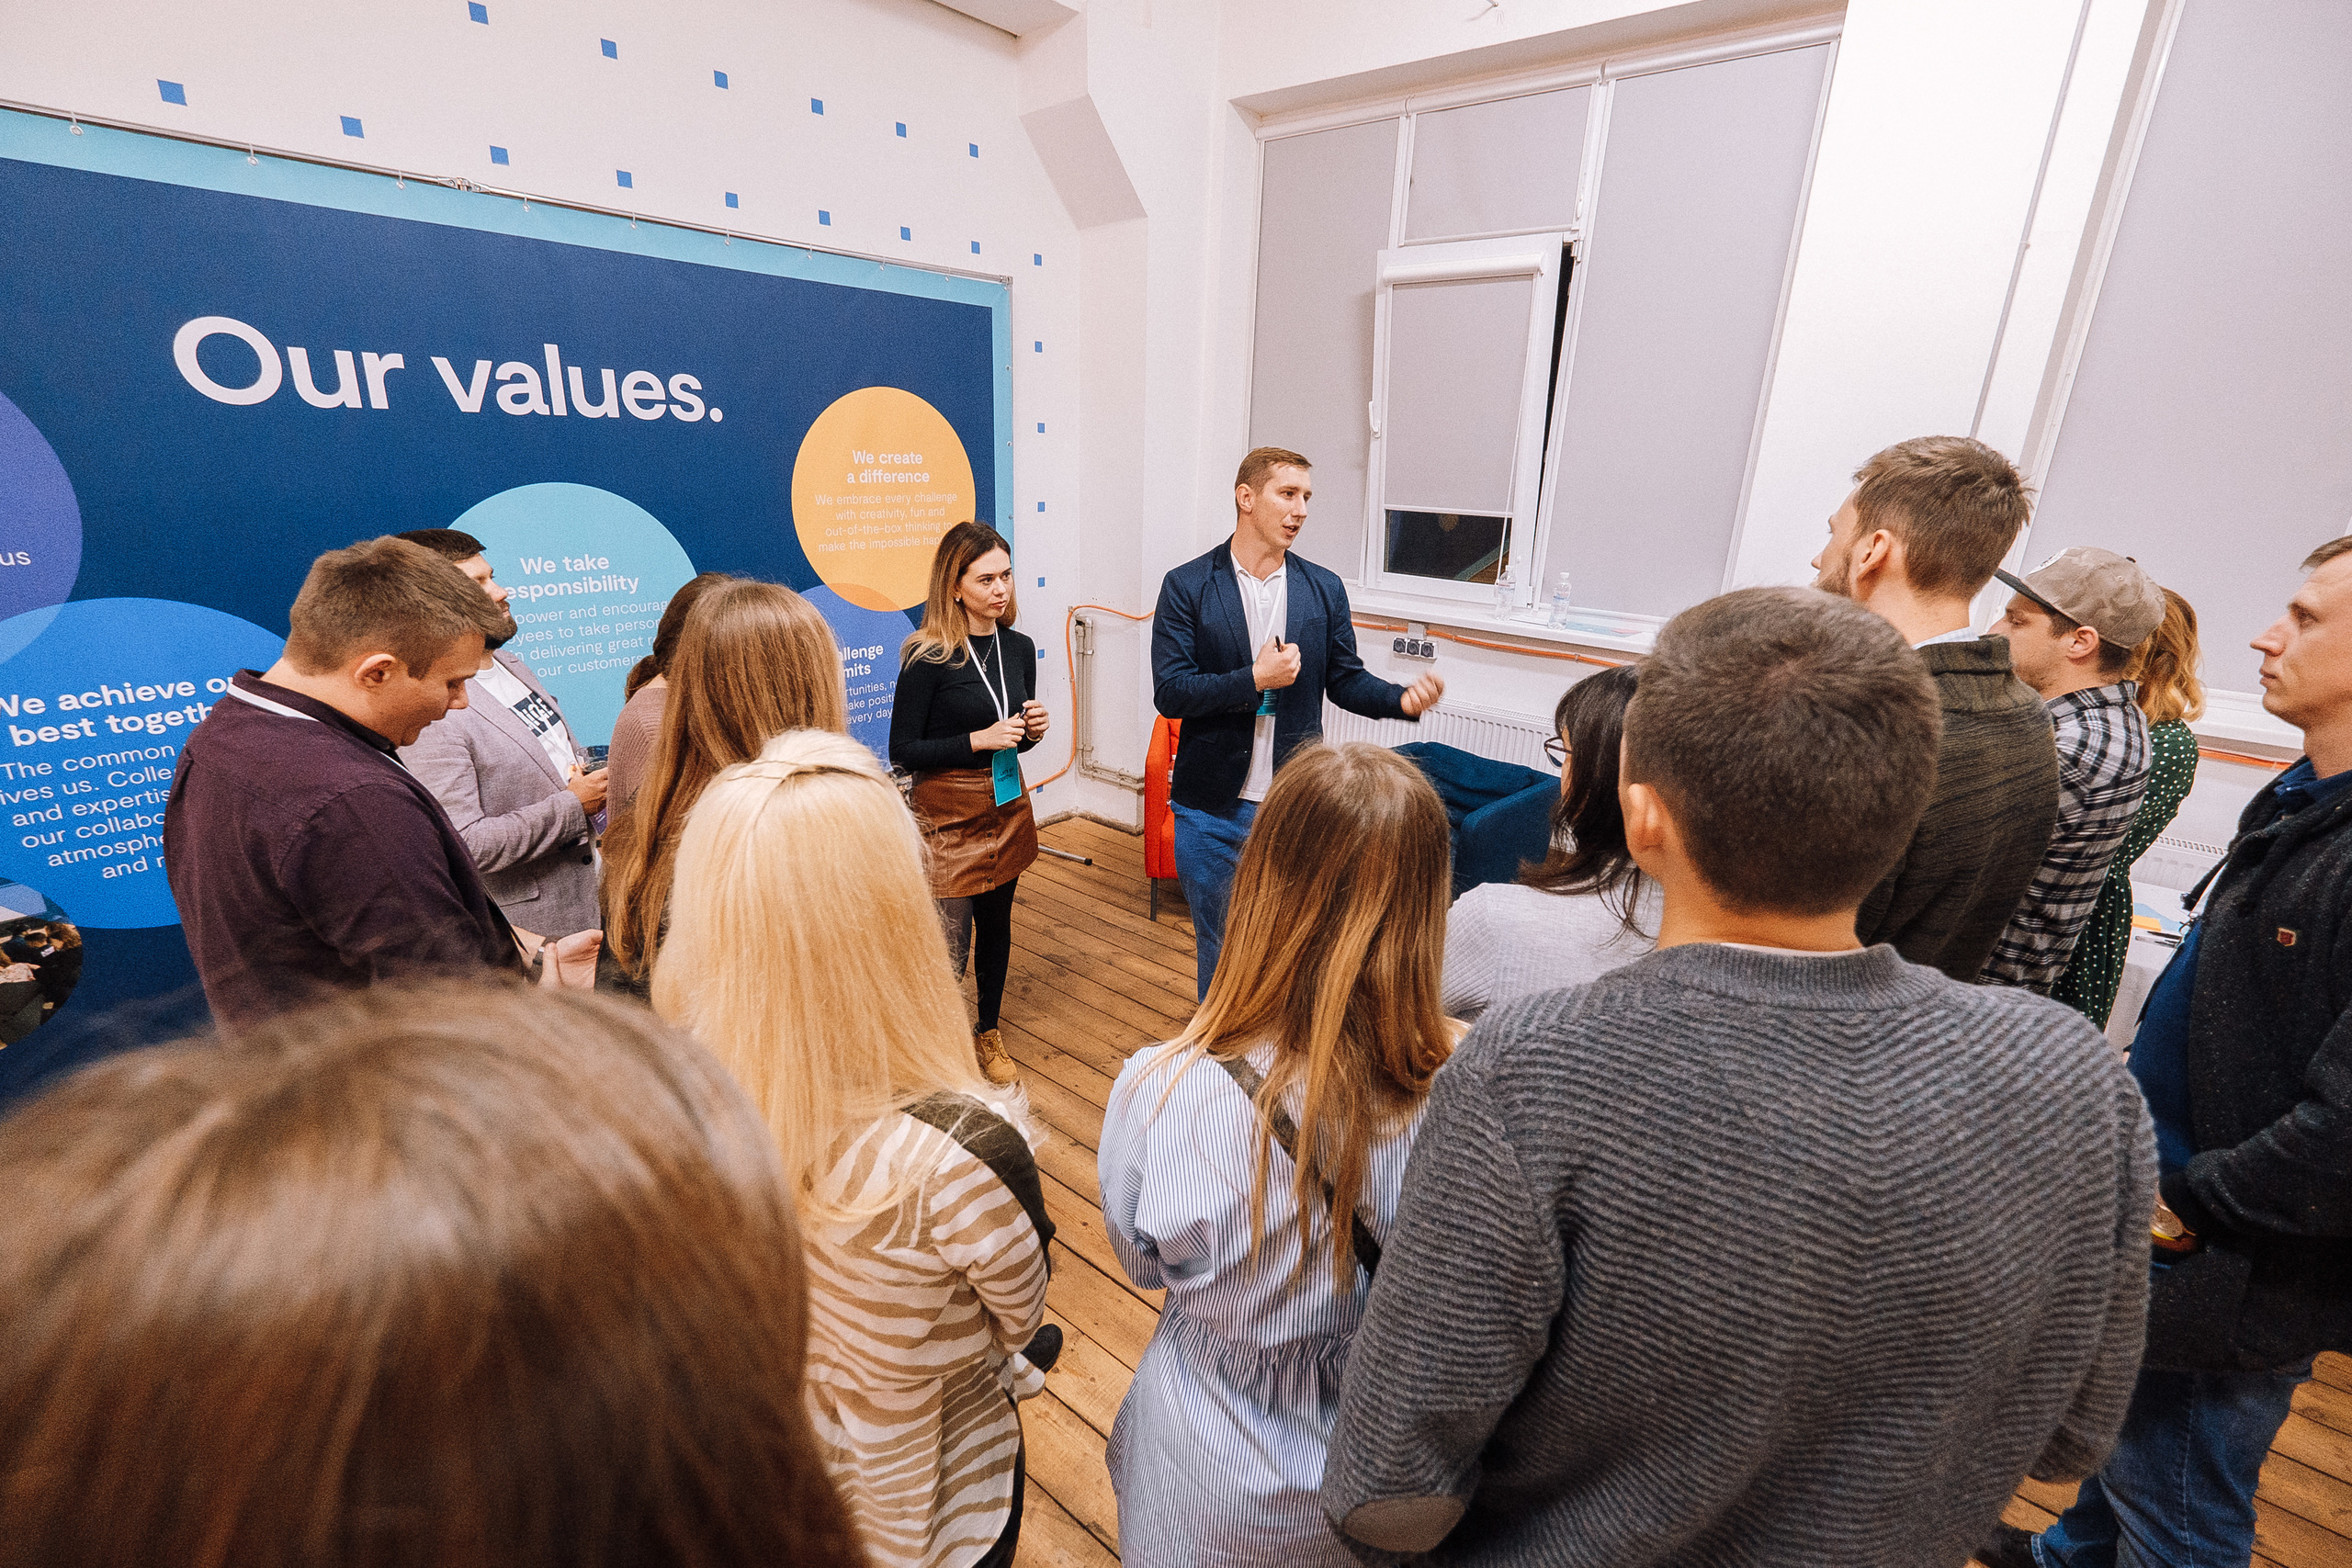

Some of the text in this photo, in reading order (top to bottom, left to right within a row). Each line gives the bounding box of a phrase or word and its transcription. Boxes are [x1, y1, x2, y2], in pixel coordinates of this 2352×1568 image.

[173, 315, 724, 423] Our values.
[853, 449, 923, 465] We create
[847, 468, 930, 484] a difference
[815, 491, 957, 505] We embrace every challenge
[835, 506, 945, 521] with creativity, fun and
[825, 521, 953, 537] out-of-the-box thinking to
[818, 535, 942, 552] make the impossible hap
[519, 554, 610, 575] We take
[506, 574, 639, 603] esponsibility
[514, 600, 670, 626] power and encourag
[558, 626, 574, 639] to
[579, 622, 610, 637] take
[529, 641, 604, 660] delivering
[608, 636, 644, 654] great
[537, 664, 563, 678] our
[843, 663, 872, 678] mits
[58, 681, 197, 711] achieve
[206, 677, 233, 694] o
[844, 682, 888, 696] rtunities,
[848, 692, 895, 711] ake positi
[8, 701, 213, 747] best togeth
[0, 744, 176, 781] The common
[0, 764, 177, 806] ives us. Colle
[12, 787, 171, 828] and expertis
[21, 811, 165, 849] our collabo
[102, 856, 149, 880] and
